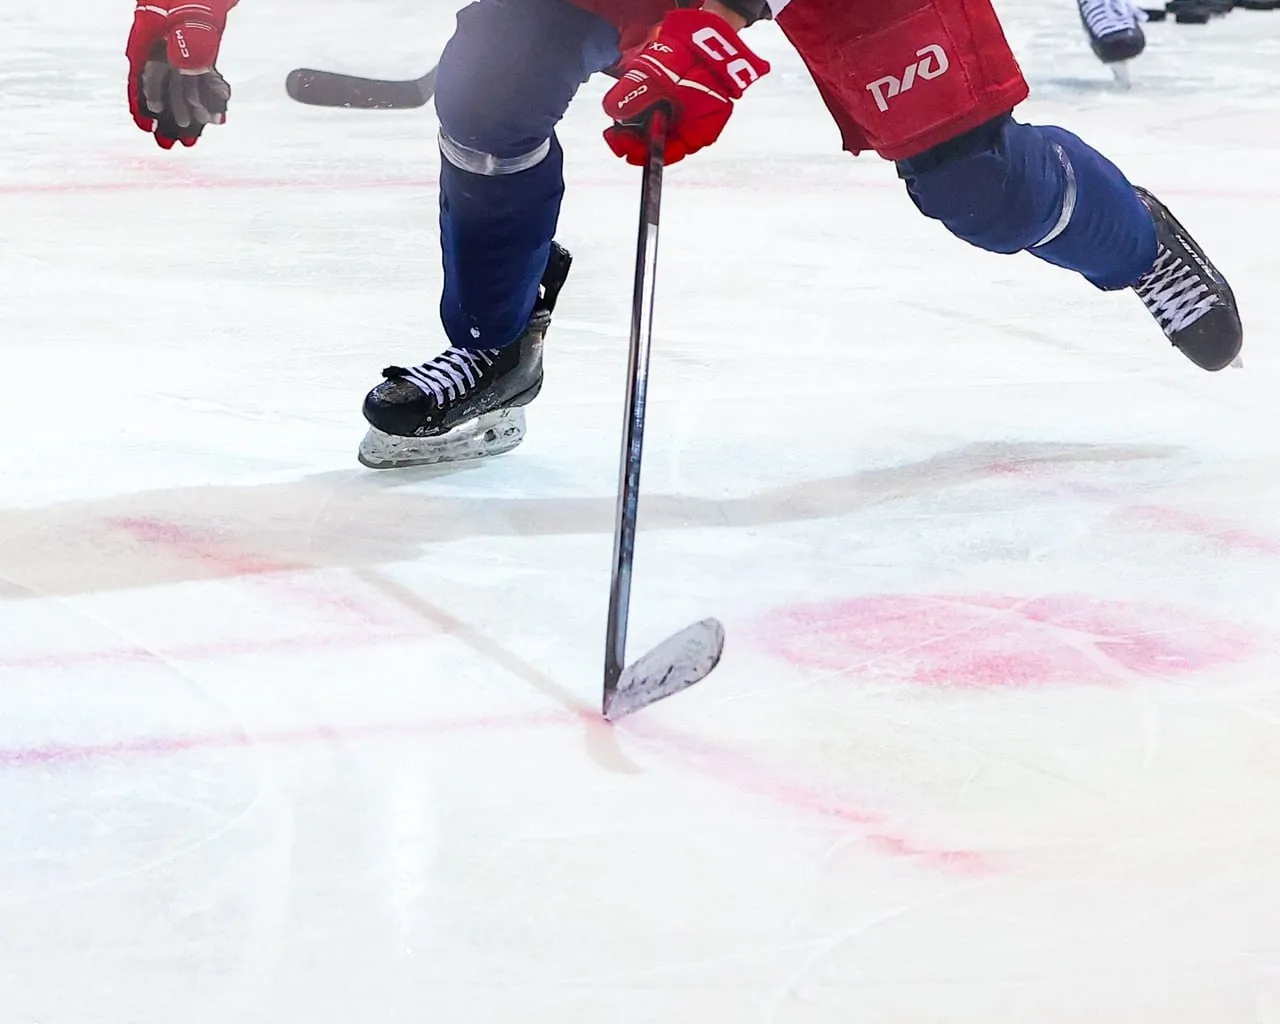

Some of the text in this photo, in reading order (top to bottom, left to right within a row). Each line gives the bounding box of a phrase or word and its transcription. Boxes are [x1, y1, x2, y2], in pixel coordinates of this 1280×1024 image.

[175, 29, 190, 59] CCM
[649, 41, 674, 54] XF
[691, 26, 761, 90] CC
[617, 84, 649, 109] CCM
